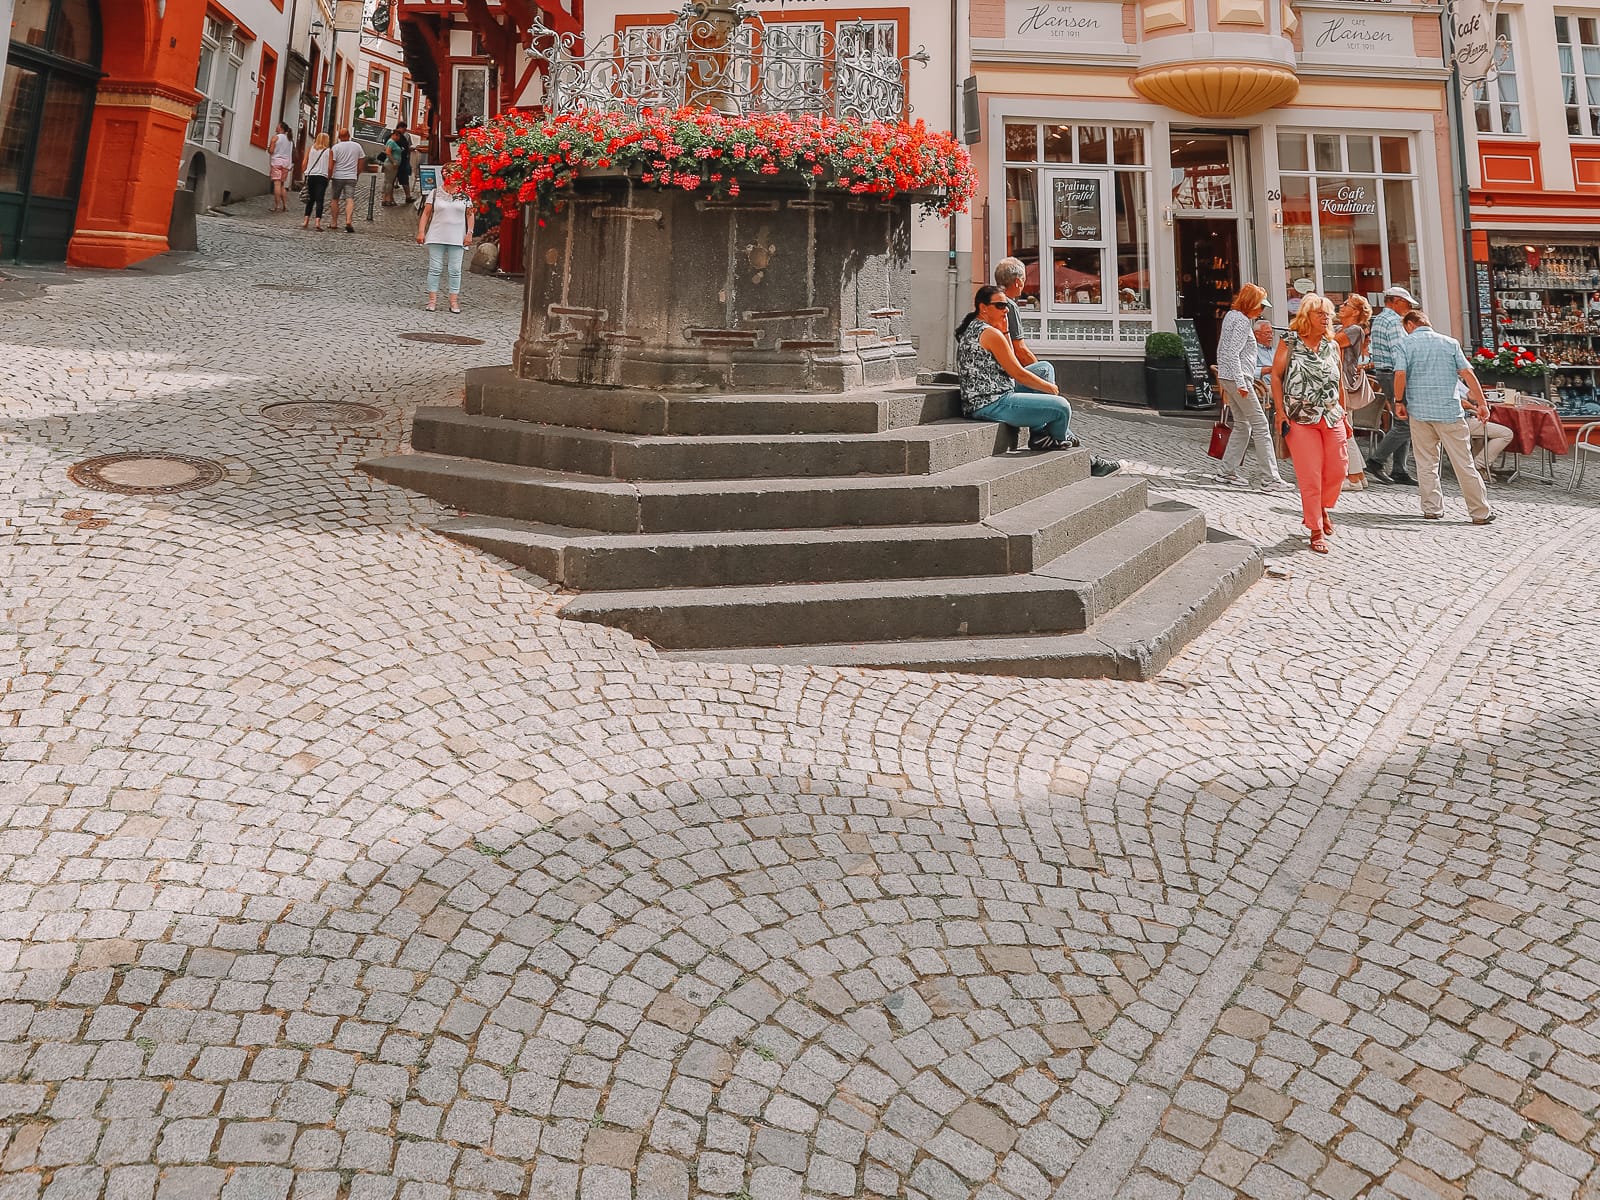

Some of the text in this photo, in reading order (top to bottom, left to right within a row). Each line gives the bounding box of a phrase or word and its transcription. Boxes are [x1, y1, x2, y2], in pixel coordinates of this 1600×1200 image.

[1017, 3, 1100, 35] Hansen
[1457, 13, 1482, 38] café
[1050, 29, 1081, 39] SEIT 1911
[1315, 16, 1394, 48] Hansen
[1346, 42, 1360, 50] SEIT
[1055, 181, 1095, 191] Pralinen
[1337, 186, 1365, 201] Café
[1267, 189, 1281, 201] 26
[1320, 199, 1376, 215] Konditorei
